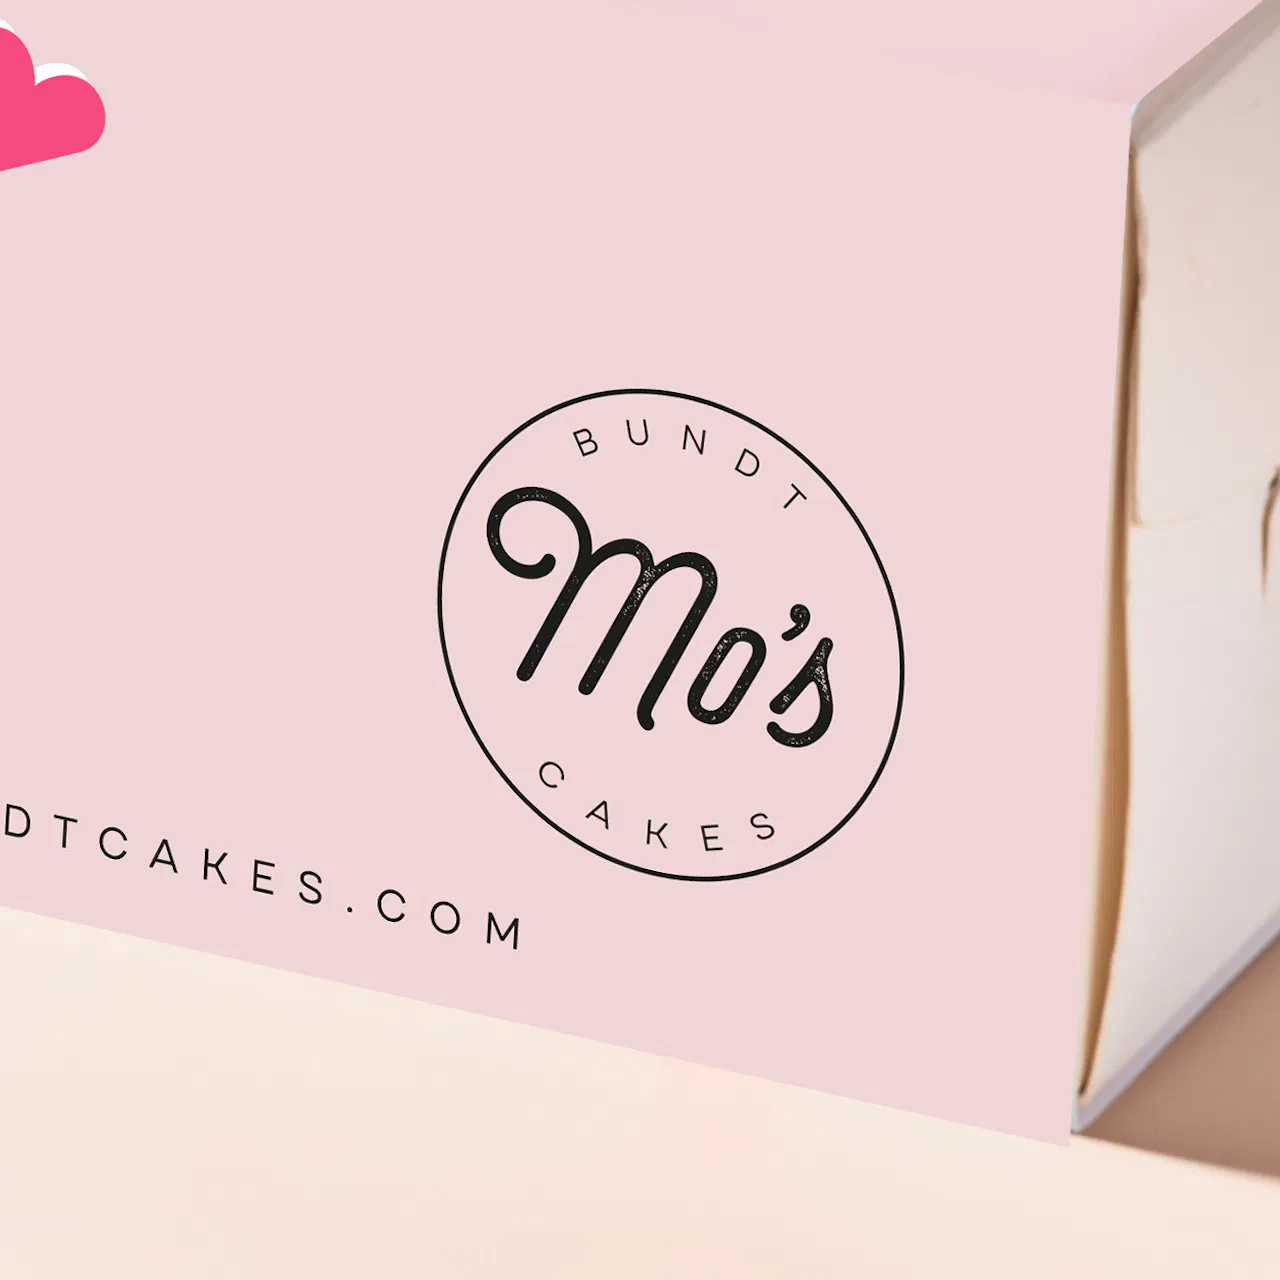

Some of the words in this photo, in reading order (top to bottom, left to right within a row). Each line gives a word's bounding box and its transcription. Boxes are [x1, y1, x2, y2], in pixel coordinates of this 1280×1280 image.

[572, 418, 808, 511] BUNDT
[486, 486, 835, 748] Mo's
[538, 760, 776, 852] CAKES
